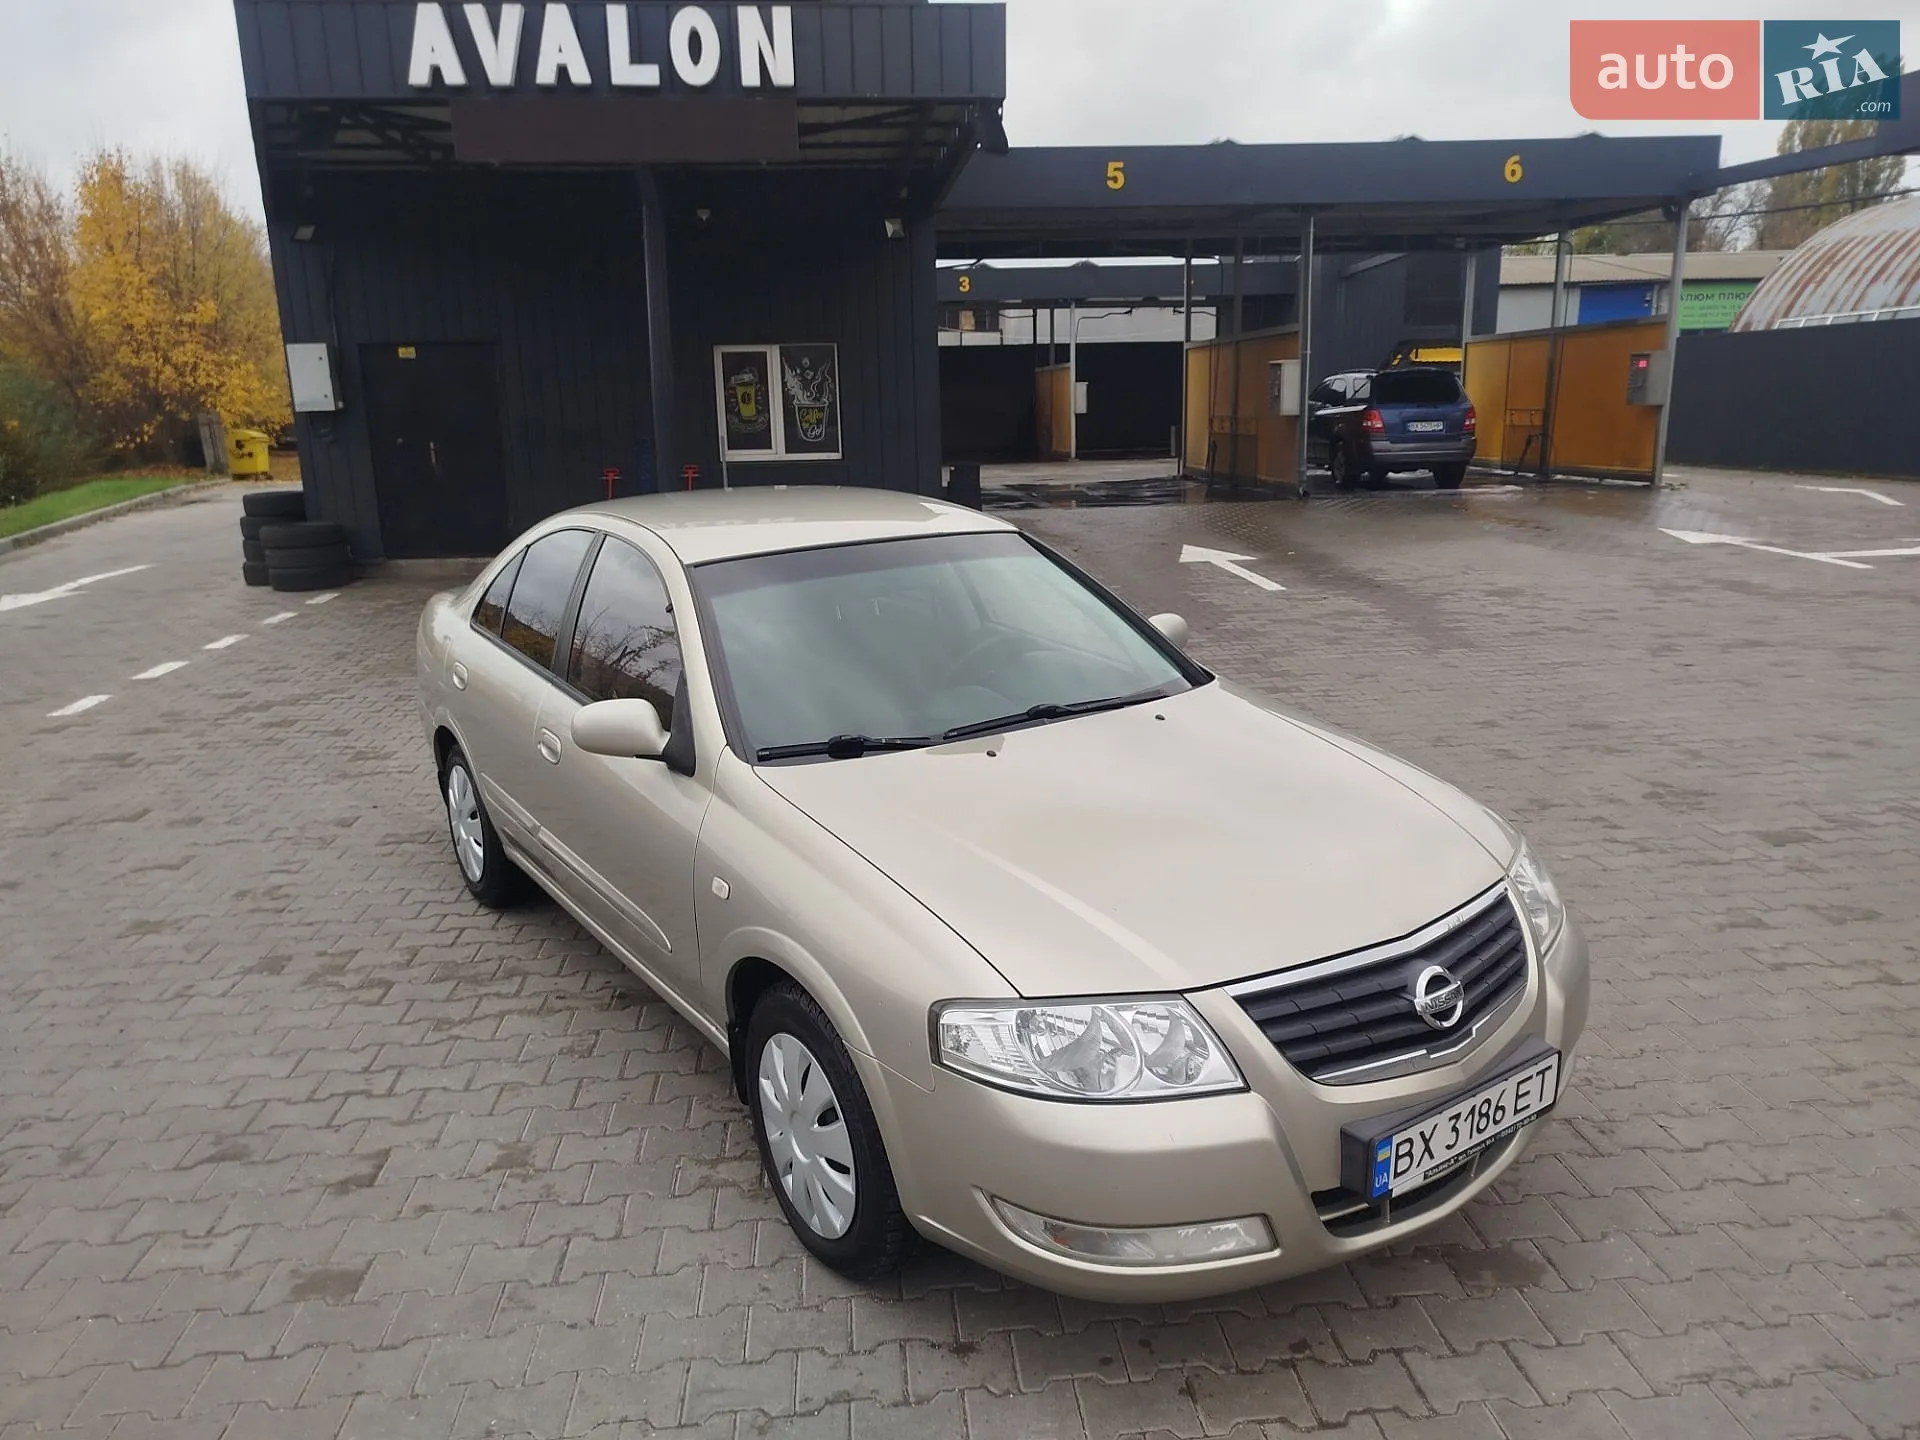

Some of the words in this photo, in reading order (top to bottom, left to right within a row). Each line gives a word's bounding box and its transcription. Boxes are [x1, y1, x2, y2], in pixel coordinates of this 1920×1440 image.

[408, 2, 795, 87] AVALON
[1107, 161, 1125, 190] 5
[1504, 155, 1523, 183] 6
[959, 275, 970, 292] 3
[1393, 1123, 1438, 1180] BX
[1445, 1088, 1507, 1150] 3186
[1513, 1065, 1552, 1116] ET
[1375, 1176, 1388, 1188] UA
